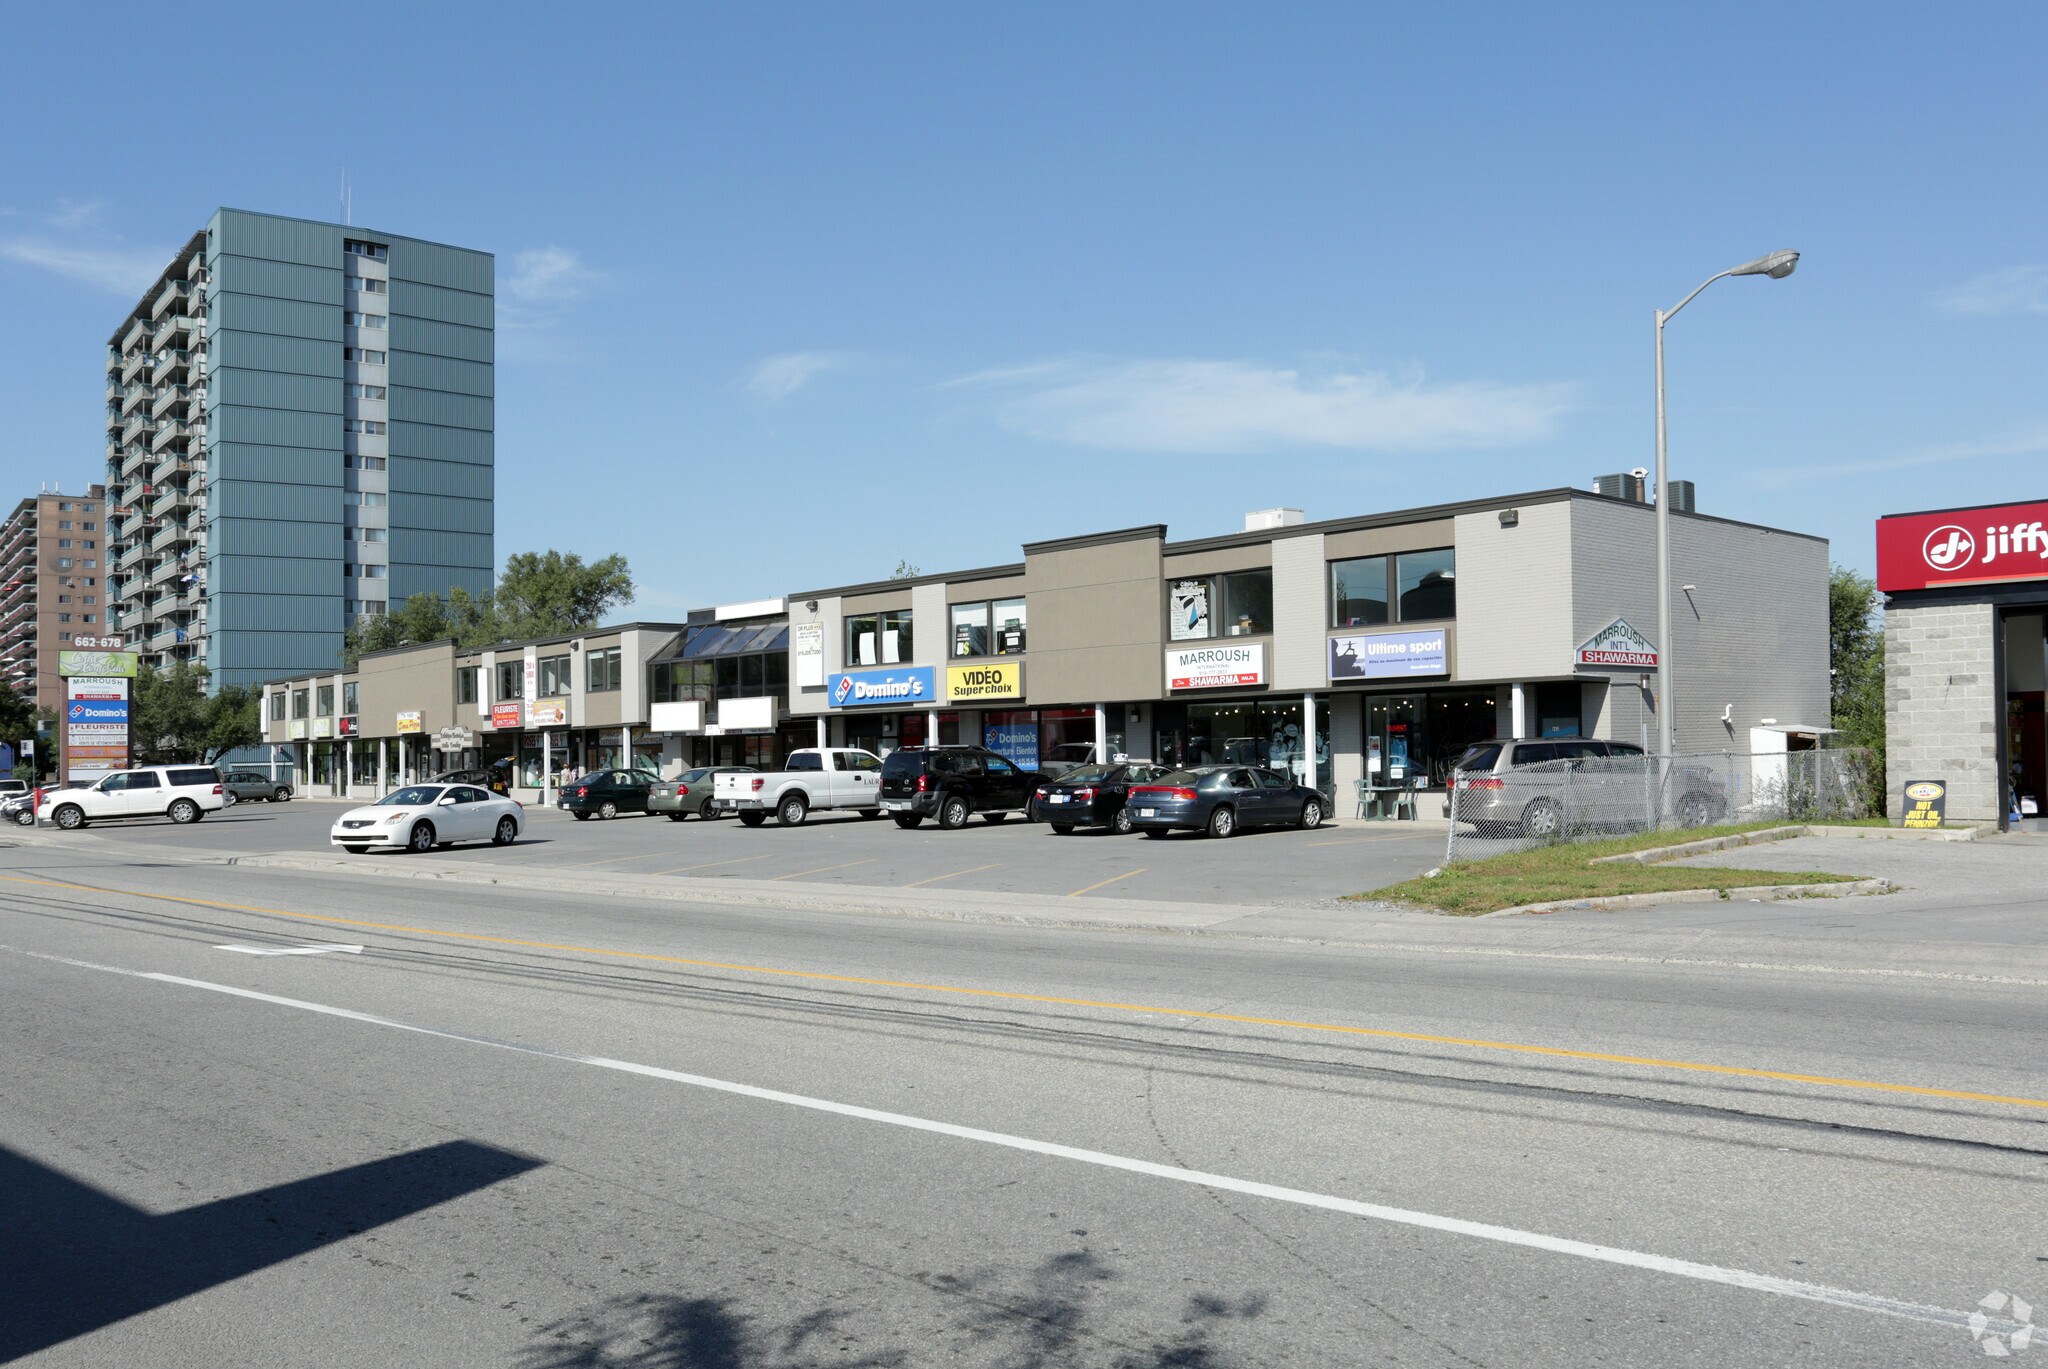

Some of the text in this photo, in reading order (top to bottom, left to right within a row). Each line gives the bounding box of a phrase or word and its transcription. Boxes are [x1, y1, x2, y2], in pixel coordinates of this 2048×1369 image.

[75, 637, 121, 647] 662-678
[1594, 625, 1644, 651] MARROUSH
[1368, 639, 1442, 655] Ultime sport
[1610, 640, 1630, 651] INT'L
[1180, 650, 1250, 666] MARROUSH
[1585, 651, 1654, 664] SHAWARMA
[963, 667, 1002, 686] VIDÉO
[1189, 675, 1239, 686] SHAWARMA
[855, 676, 924, 699] Domino's
[85, 708, 127, 717] Domino's
[494, 705, 518, 714] FLEURISTE
[999, 731, 1037, 743] Domino's
[1916, 801, 1932, 810] NOT
[1905, 810, 1926, 819] JUST
